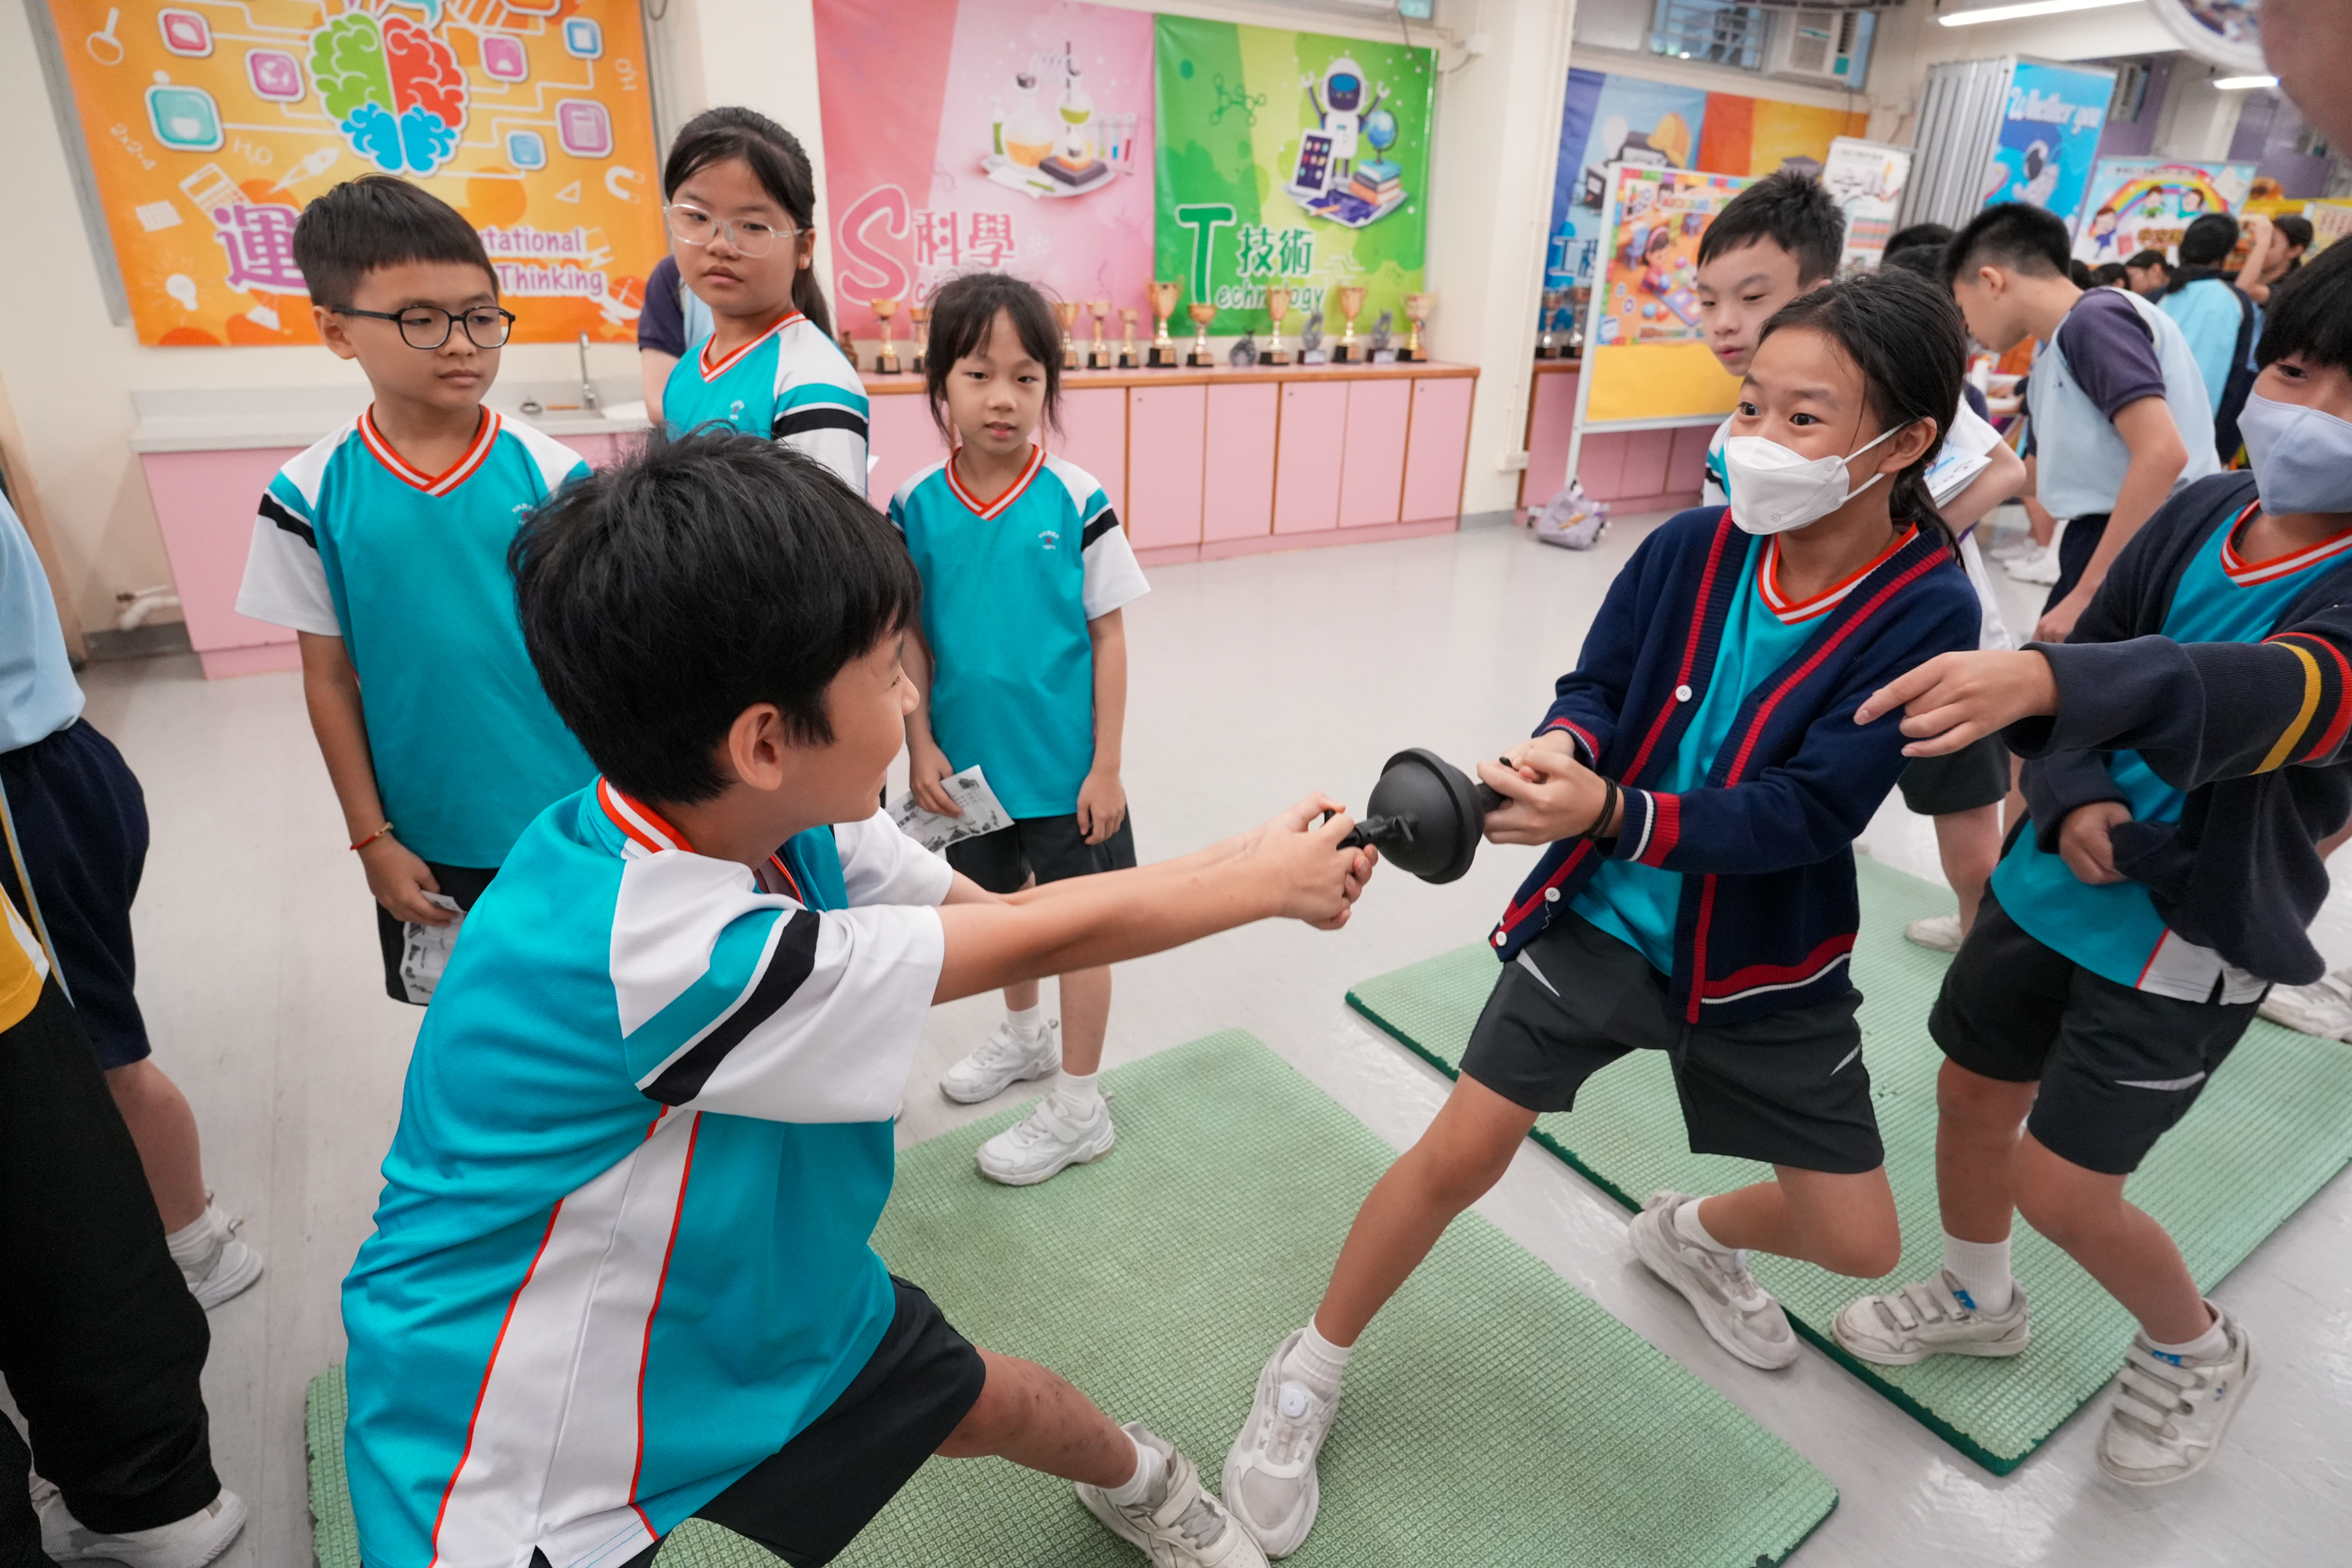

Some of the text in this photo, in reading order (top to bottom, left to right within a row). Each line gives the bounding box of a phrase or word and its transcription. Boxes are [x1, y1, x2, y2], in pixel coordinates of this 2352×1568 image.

[913, 211, 1015, 267] 科學
[1237, 226, 1315, 274] 技術
[495, 264, 603, 296] Thinking
[1218, 278, 1323, 311] echnogy
